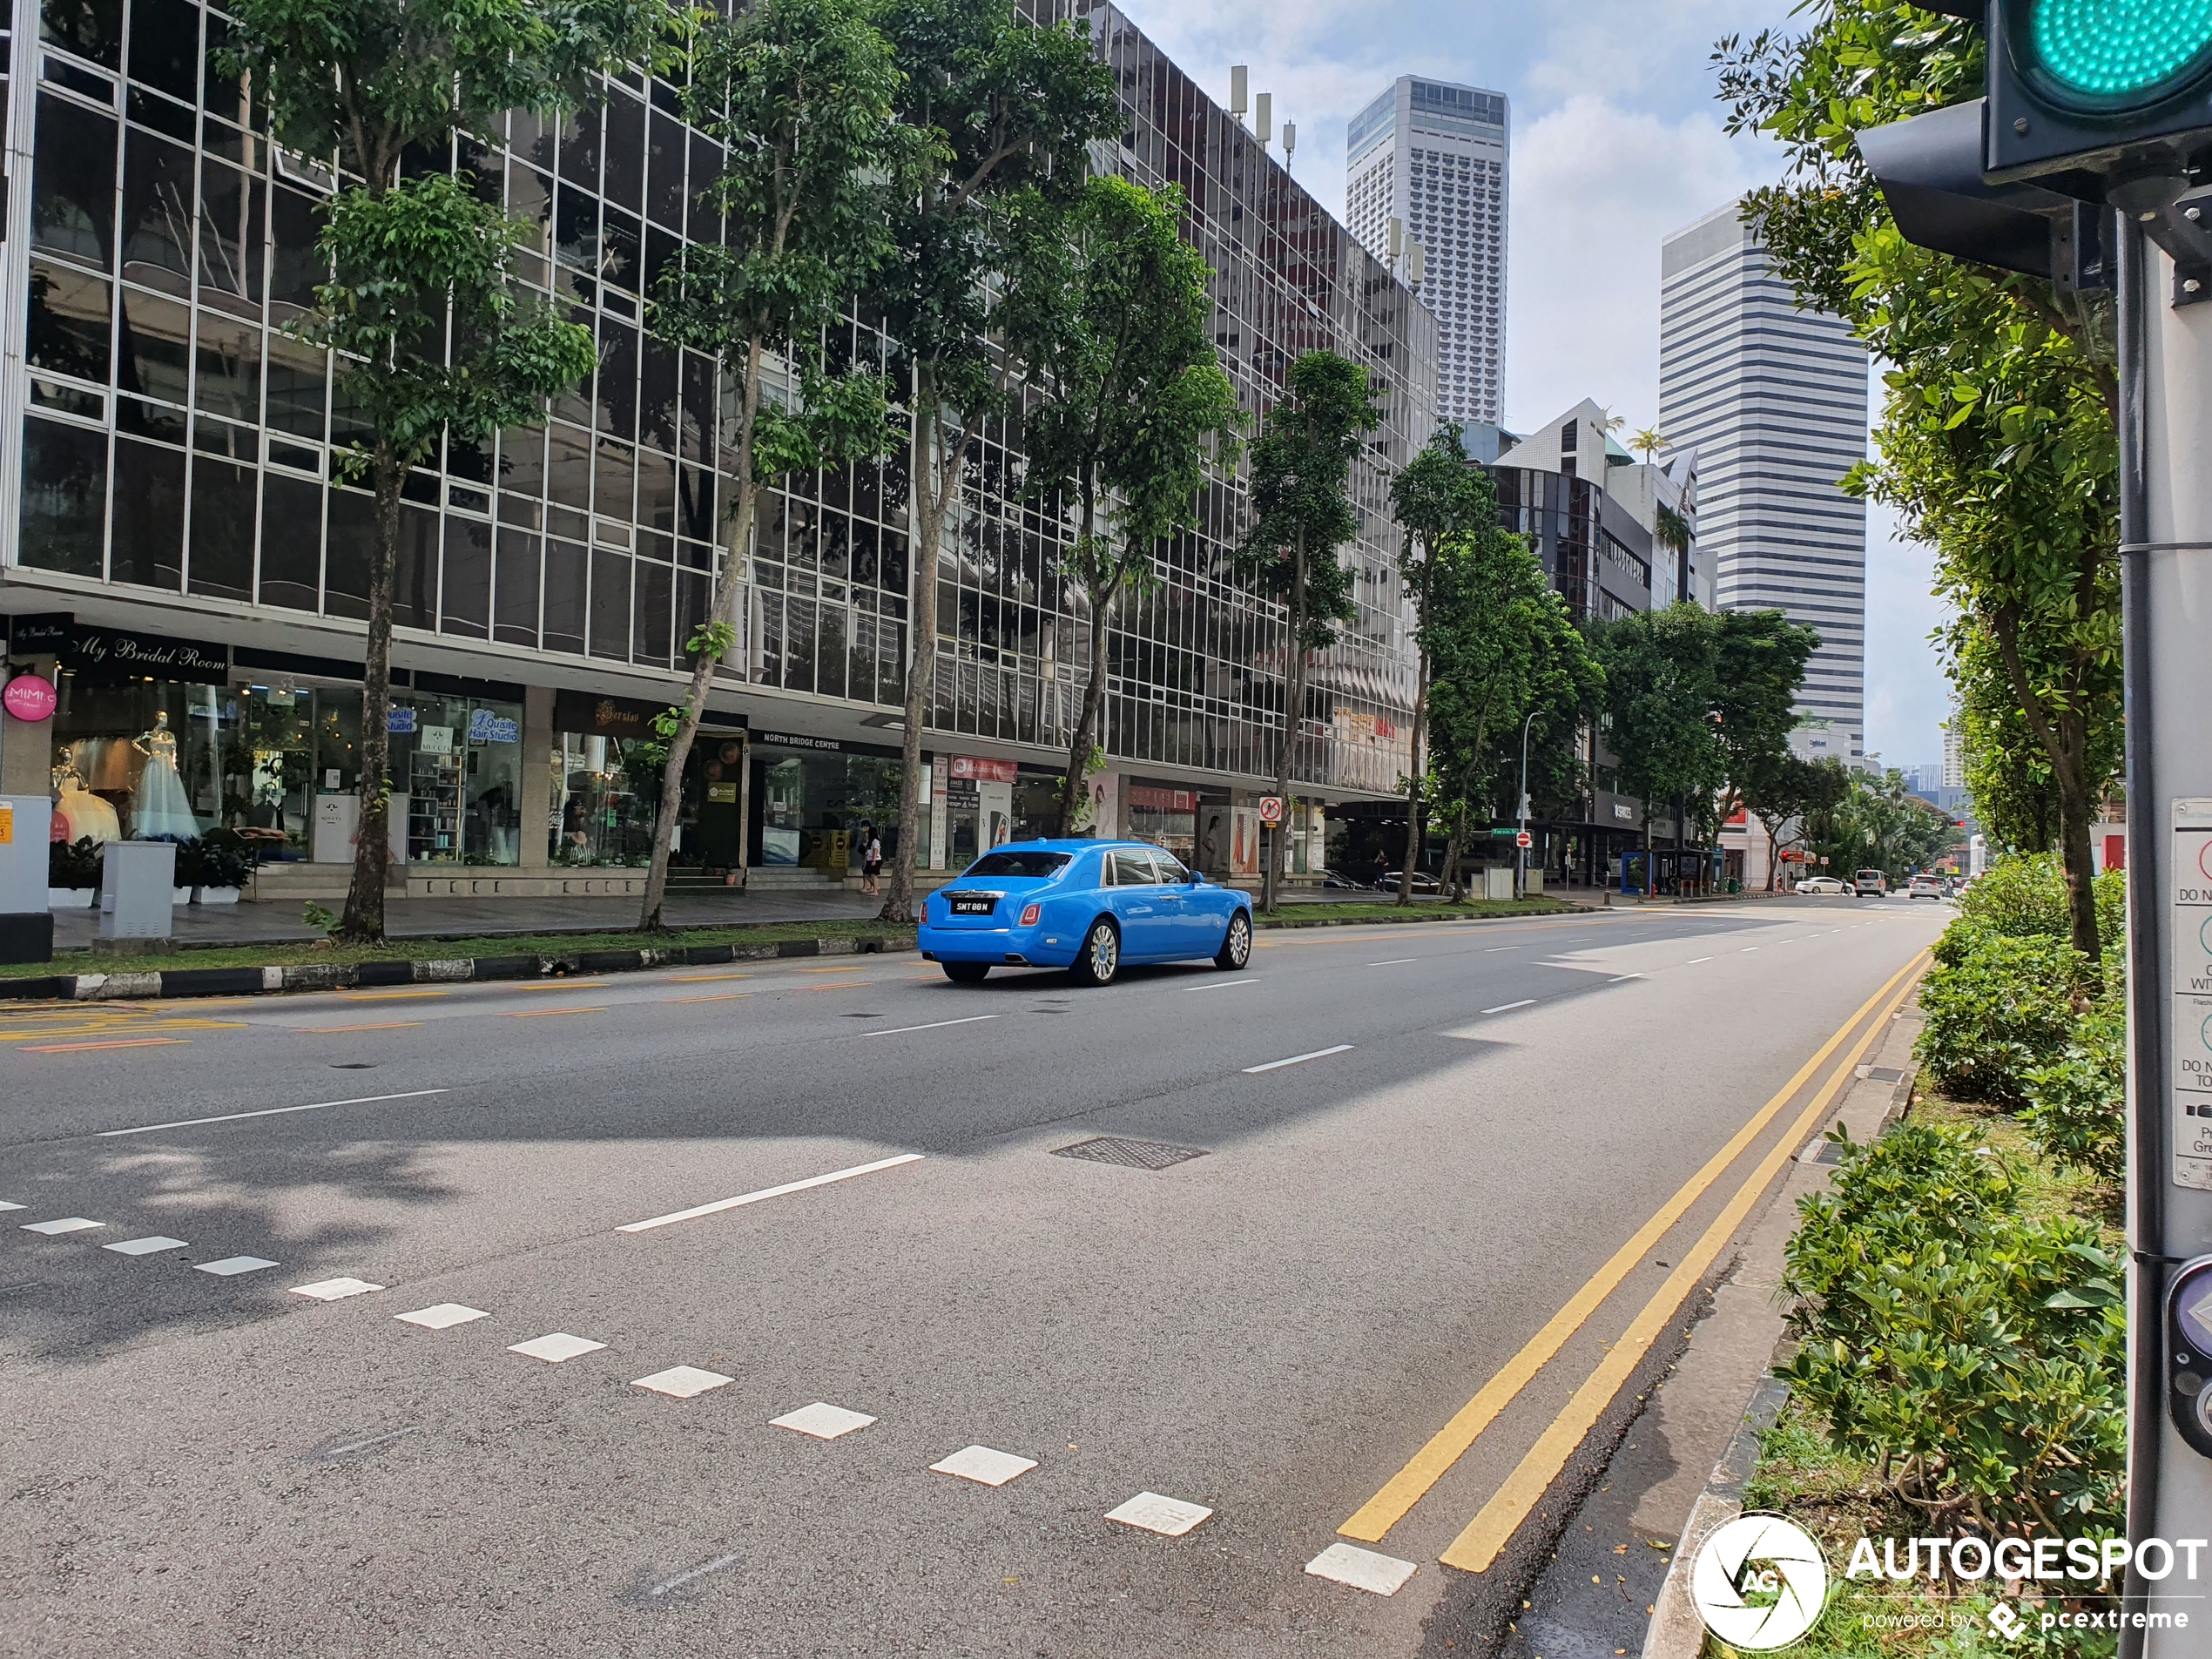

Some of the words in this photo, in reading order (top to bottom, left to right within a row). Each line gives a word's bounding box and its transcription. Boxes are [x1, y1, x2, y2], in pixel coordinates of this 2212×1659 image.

[72, 636, 107, 662] My
[114, 638, 177, 664] Bridal
[178, 646, 226, 670] Room
[469, 728, 489, 738] Hair
[489, 730, 517, 742] Studio
[764, 733, 788, 744] NORTH
[789, 736, 813, 747] BRIDGE
[814, 739, 840, 750] CENTRE
[2180, 889, 2198, 900] DO
[2182, 1060, 2201, 1072] DO
